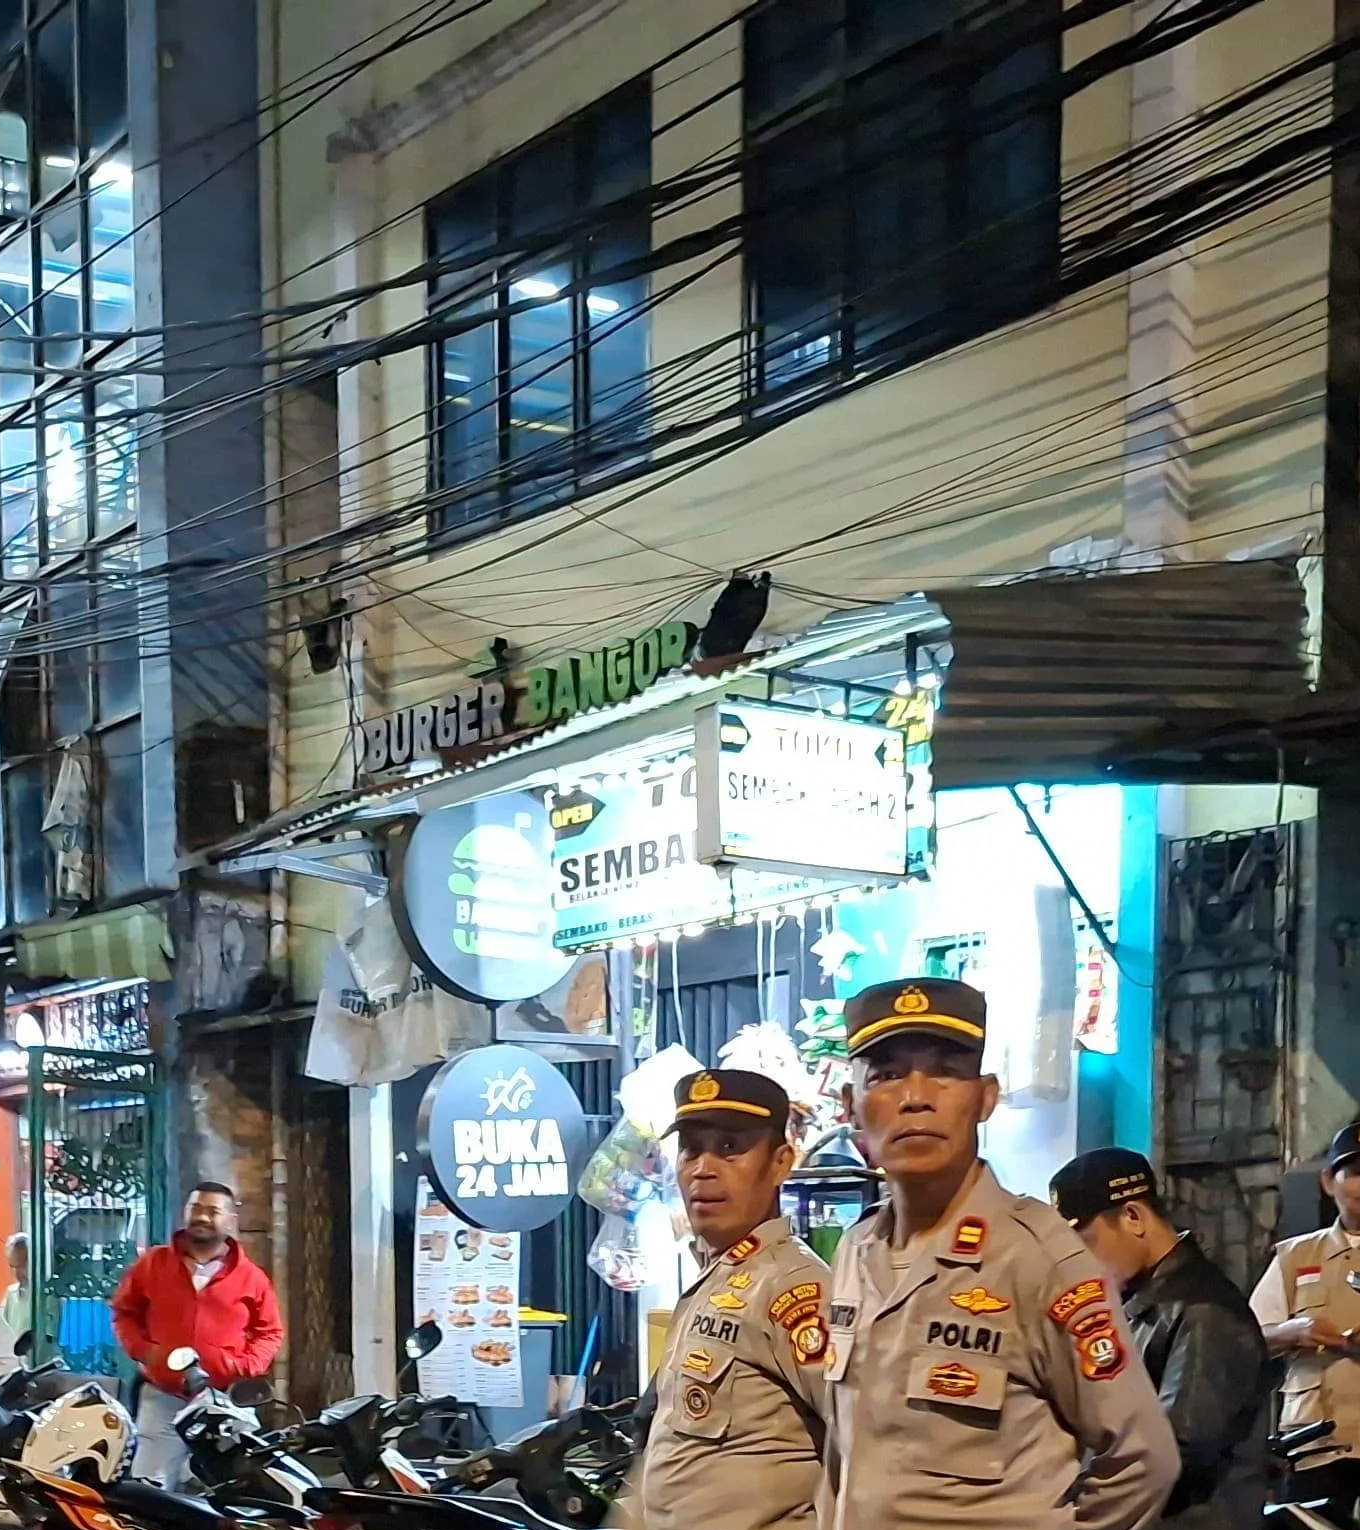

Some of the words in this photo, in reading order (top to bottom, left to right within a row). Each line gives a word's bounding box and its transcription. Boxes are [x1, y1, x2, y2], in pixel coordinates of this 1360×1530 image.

[364, 680, 506, 773] BURGER
[527, 621, 694, 727] BANGOR
[551, 803, 593, 829] OPEN
[560, 834, 686, 893] SEMBA
[555, 921, 608, 940] SEMBAKO
[453, 1119, 566, 1165] BUKA
[455, 1165, 497, 1197] 24
[502, 1163, 569, 1197] JAM
[691, 1313, 740, 1344] POLRI
[927, 1321, 1002, 1354] POLRI
